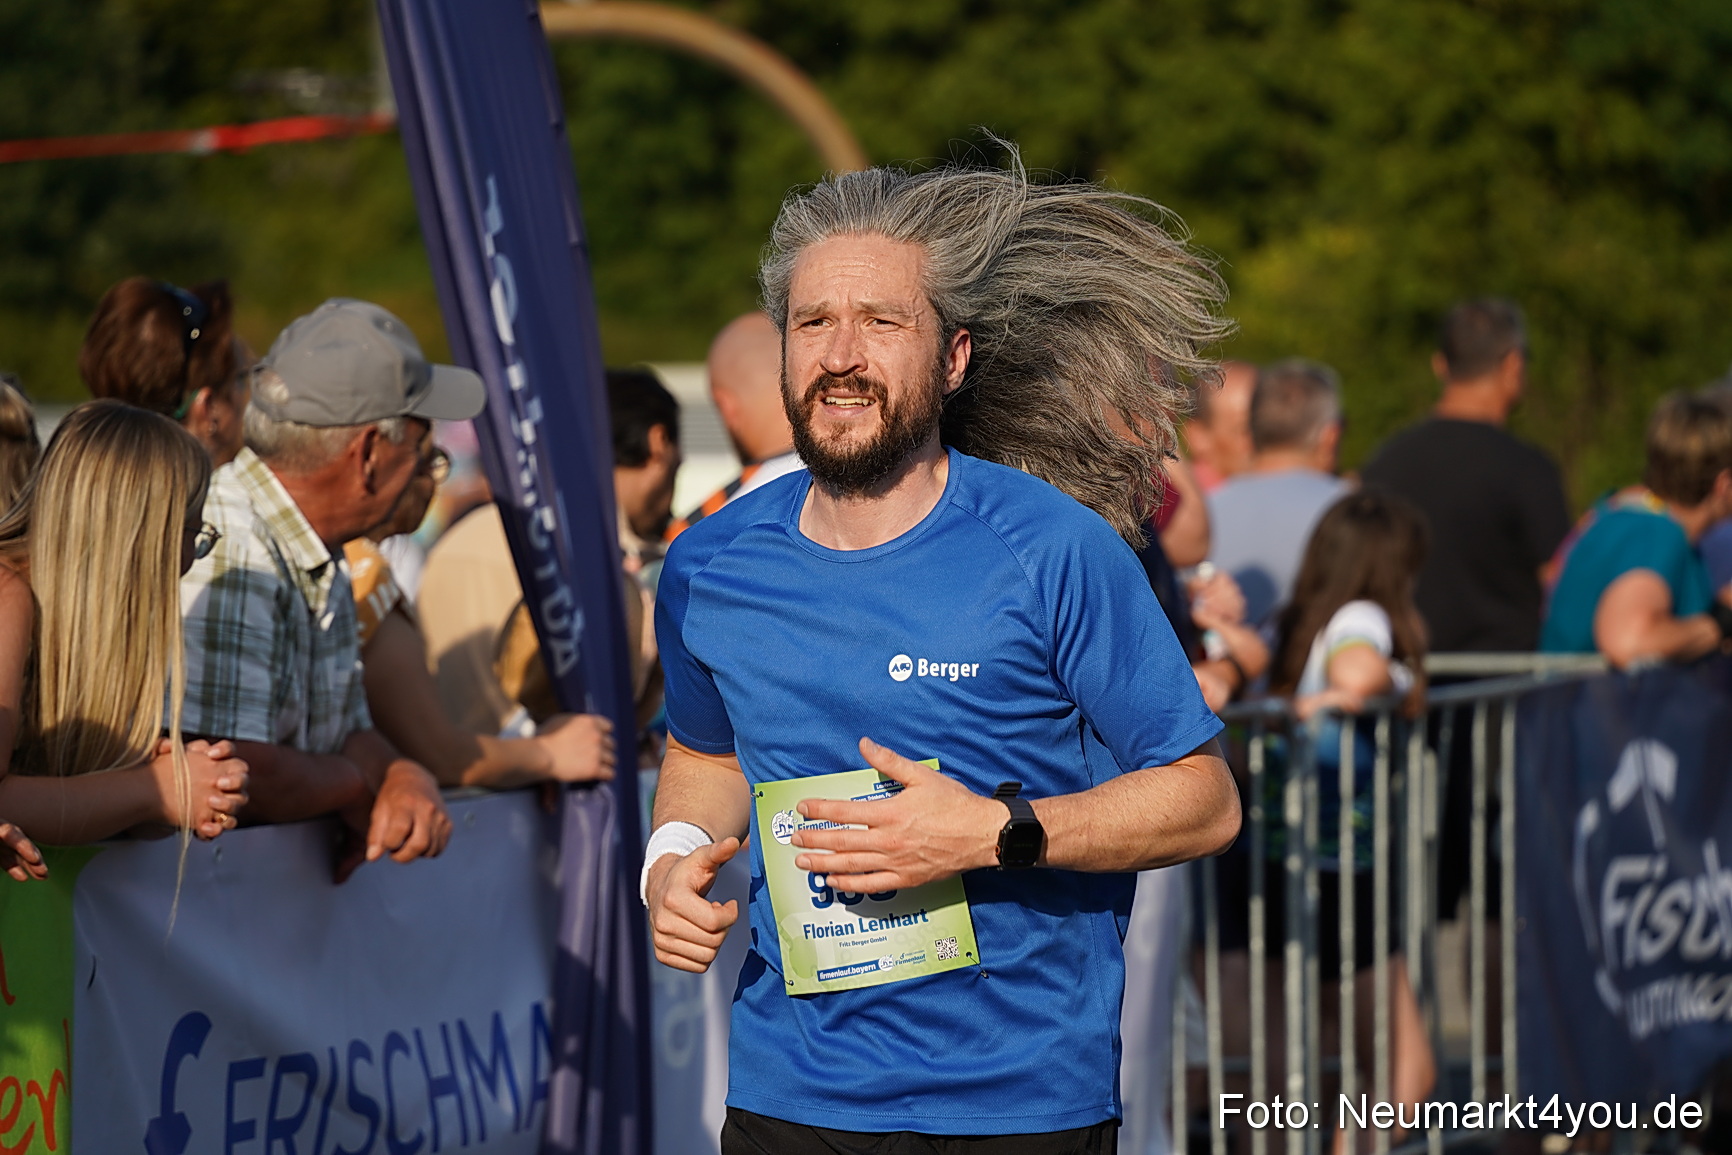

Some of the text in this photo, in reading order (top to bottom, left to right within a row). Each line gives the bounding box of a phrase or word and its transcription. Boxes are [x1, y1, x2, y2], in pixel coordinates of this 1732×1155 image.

[917, 658, 980, 682] Berger
[803, 908, 929, 940] Florian Lenhart
[851, 938, 870, 947] Berger
[869, 936, 888, 944] GmbH
[895, 953, 926, 966] Firmenlauf
[819, 963, 877, 980] firmenlauf.bayern
